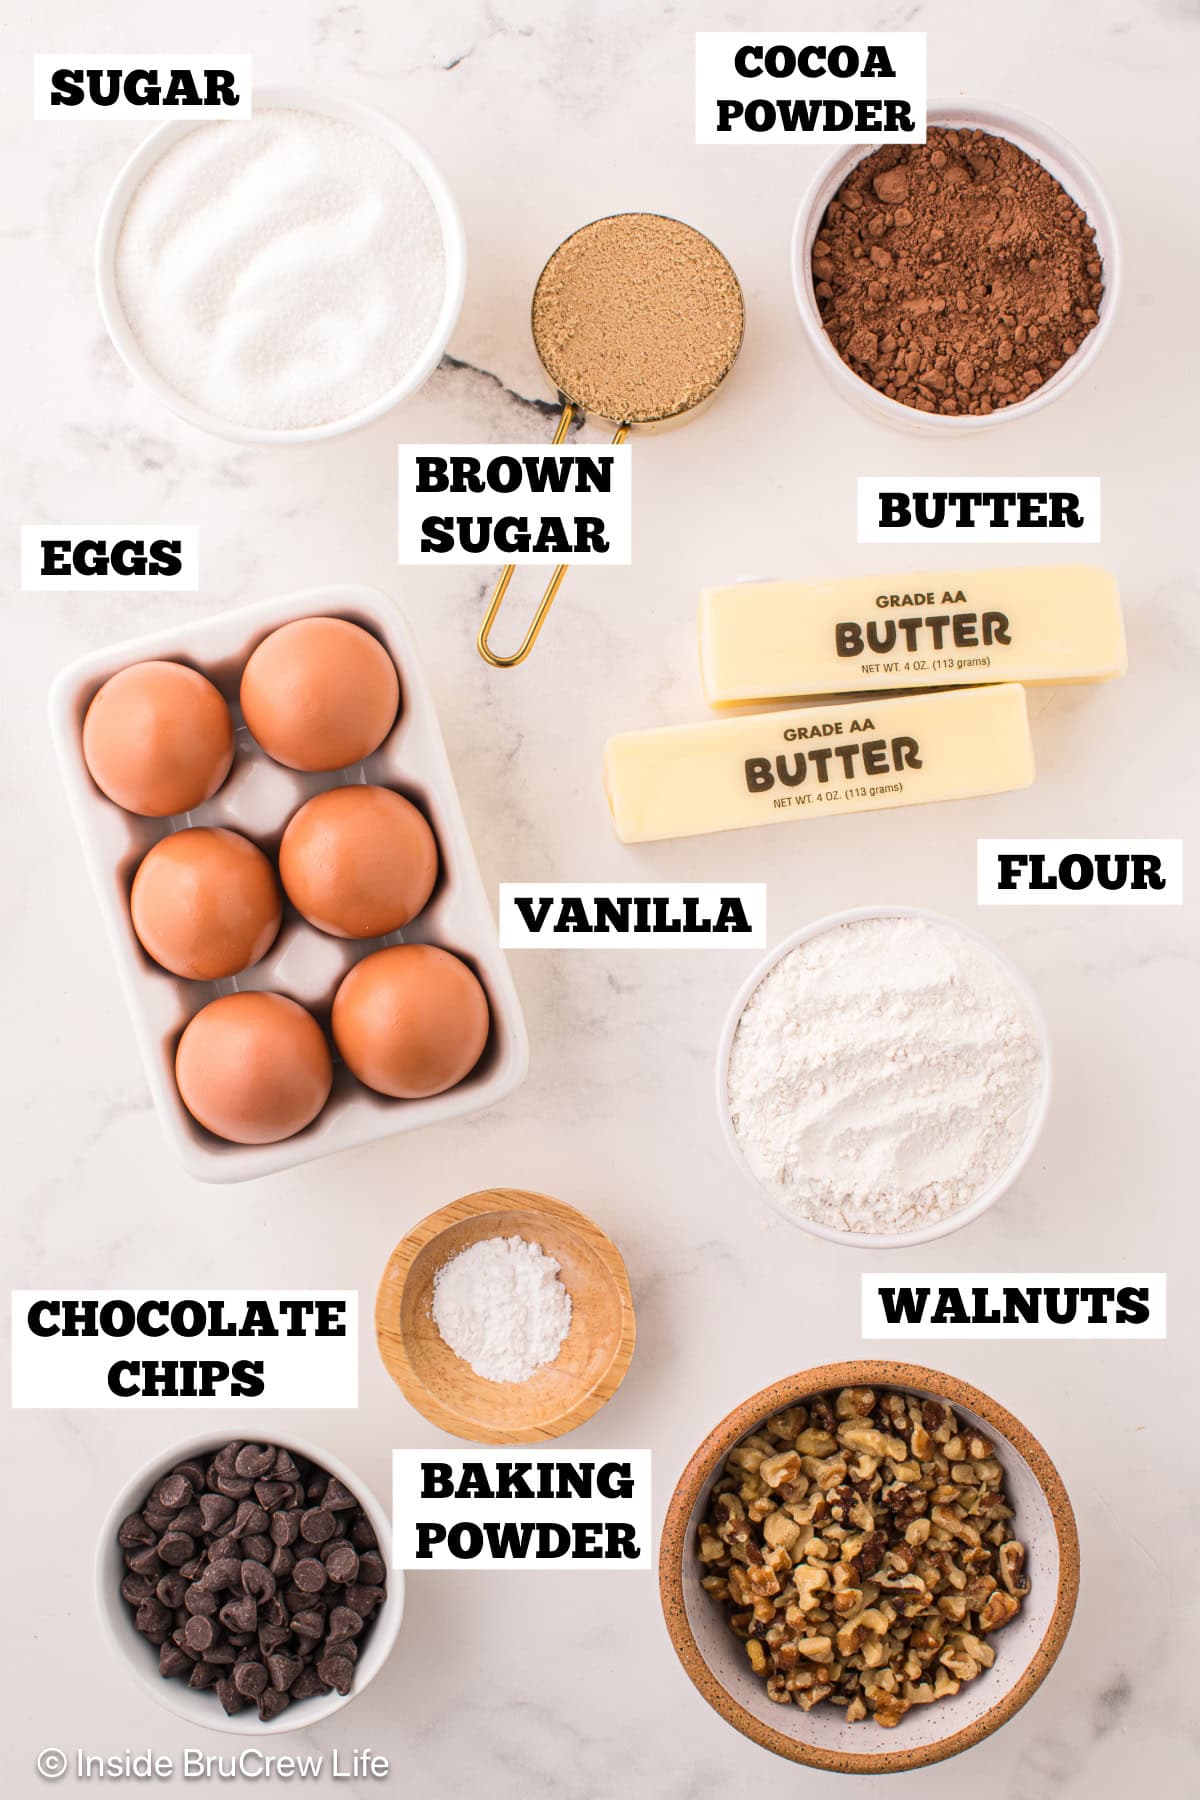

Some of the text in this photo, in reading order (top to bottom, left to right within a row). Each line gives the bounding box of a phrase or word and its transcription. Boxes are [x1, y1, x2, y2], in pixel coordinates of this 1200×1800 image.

[875, 590, 967, 608] GRADE AA
[835, 611, 1012, 658] BUTTER
[861, 656, 990, 674] NET WT. 4 OZ. (113 grams)
[783, 718, 876, 742] GRADE AA
[744, 736, 923, 793] BUTTER
[773, 782, 903, 808] NET WT. 4 OZ. (113 grams)
